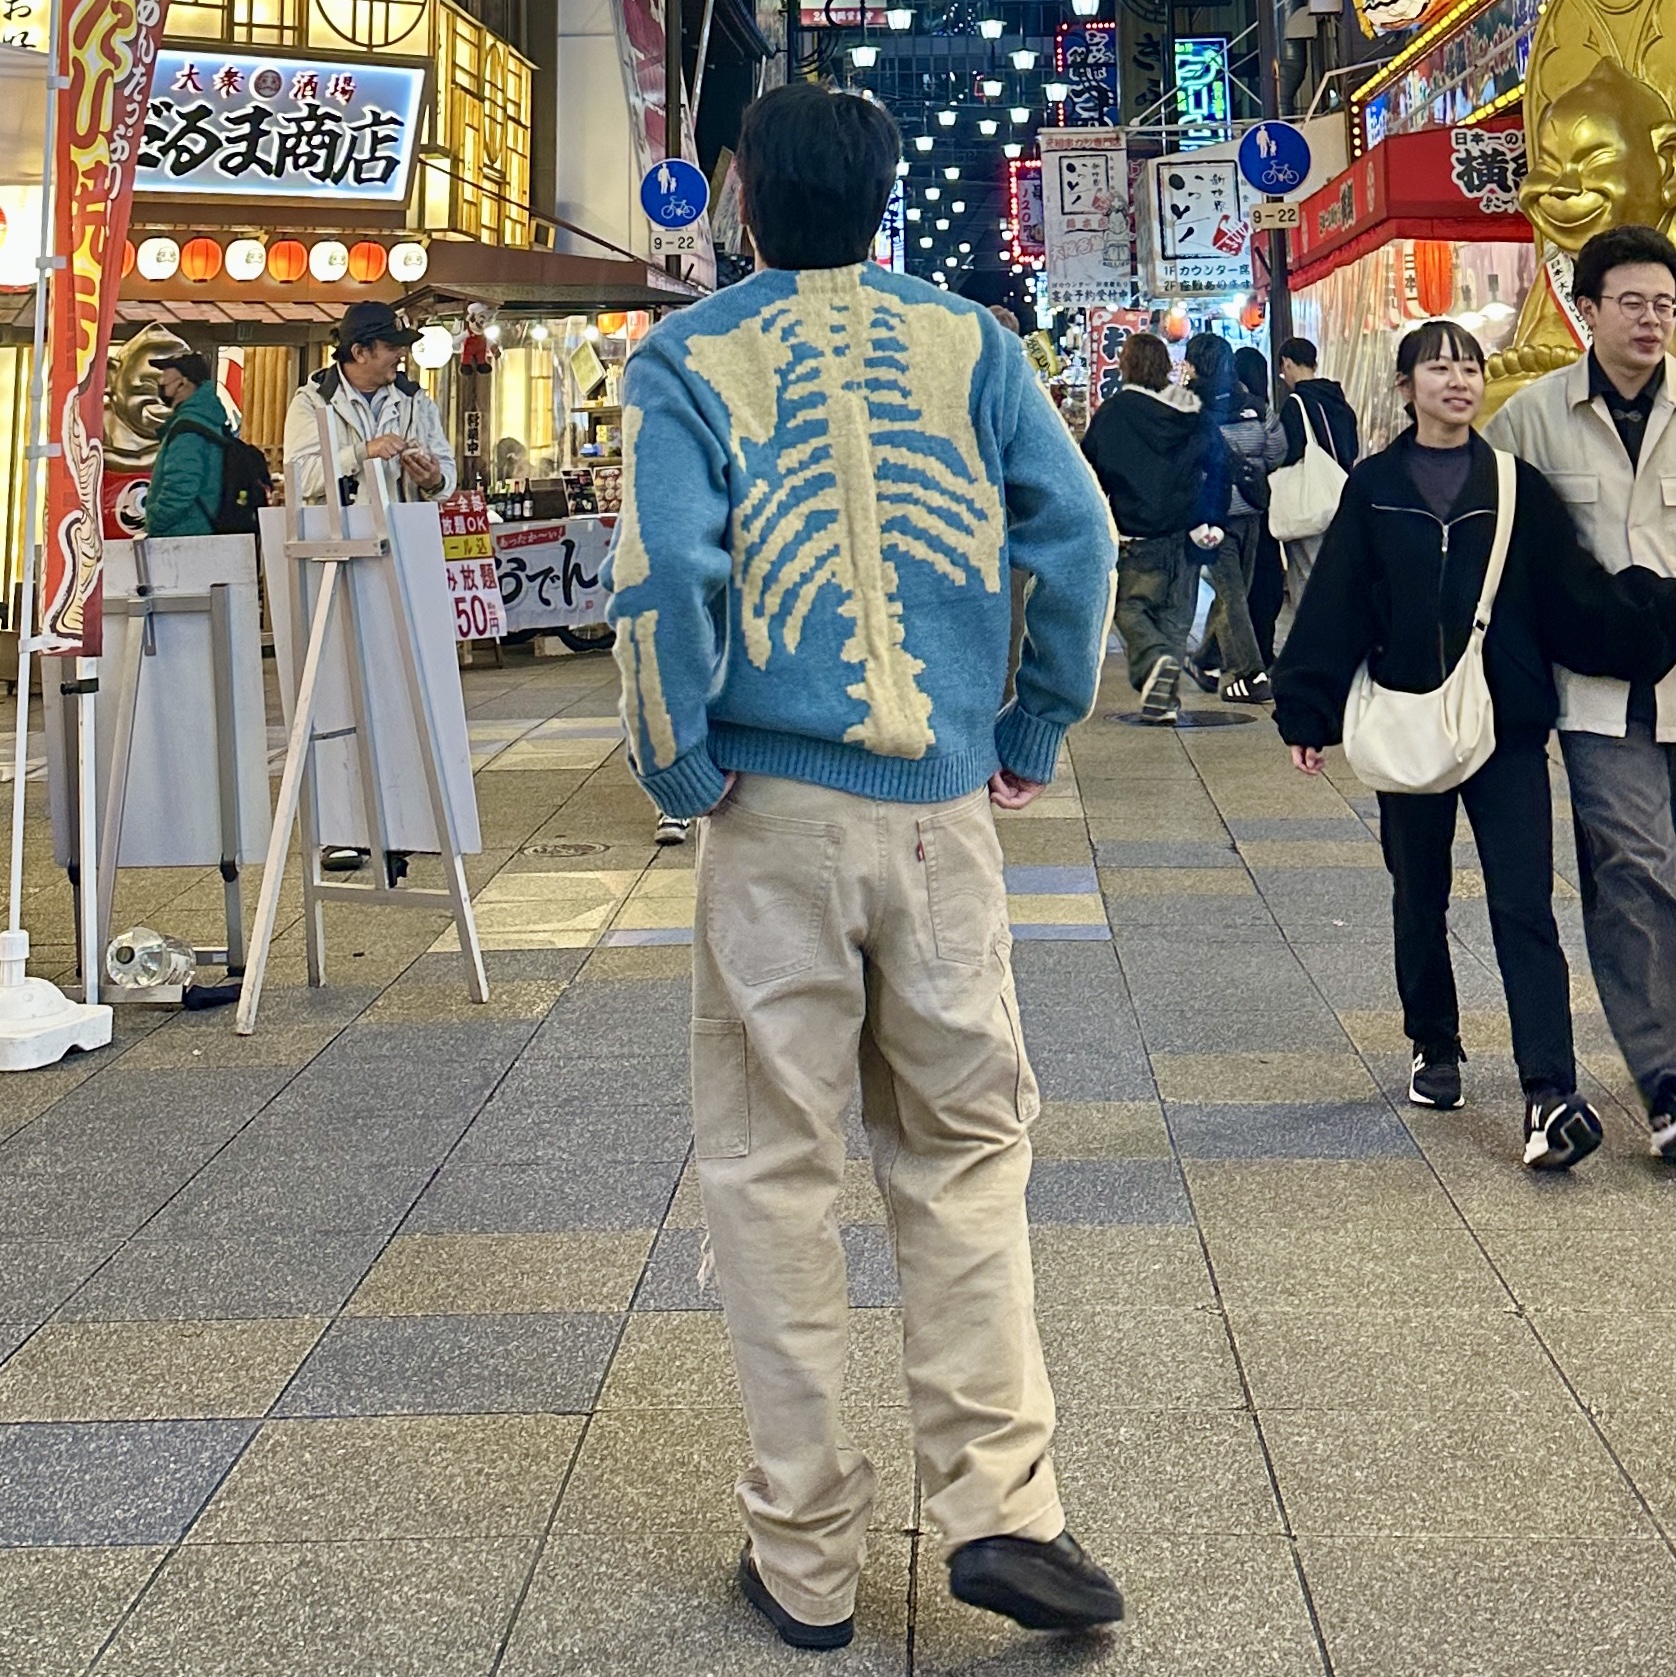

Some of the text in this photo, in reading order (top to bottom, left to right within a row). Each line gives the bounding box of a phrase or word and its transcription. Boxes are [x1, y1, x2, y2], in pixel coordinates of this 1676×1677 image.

[171, 60, 357, 104] 大衆酒場
[1454, 131, 1525, 146] 日本一の
